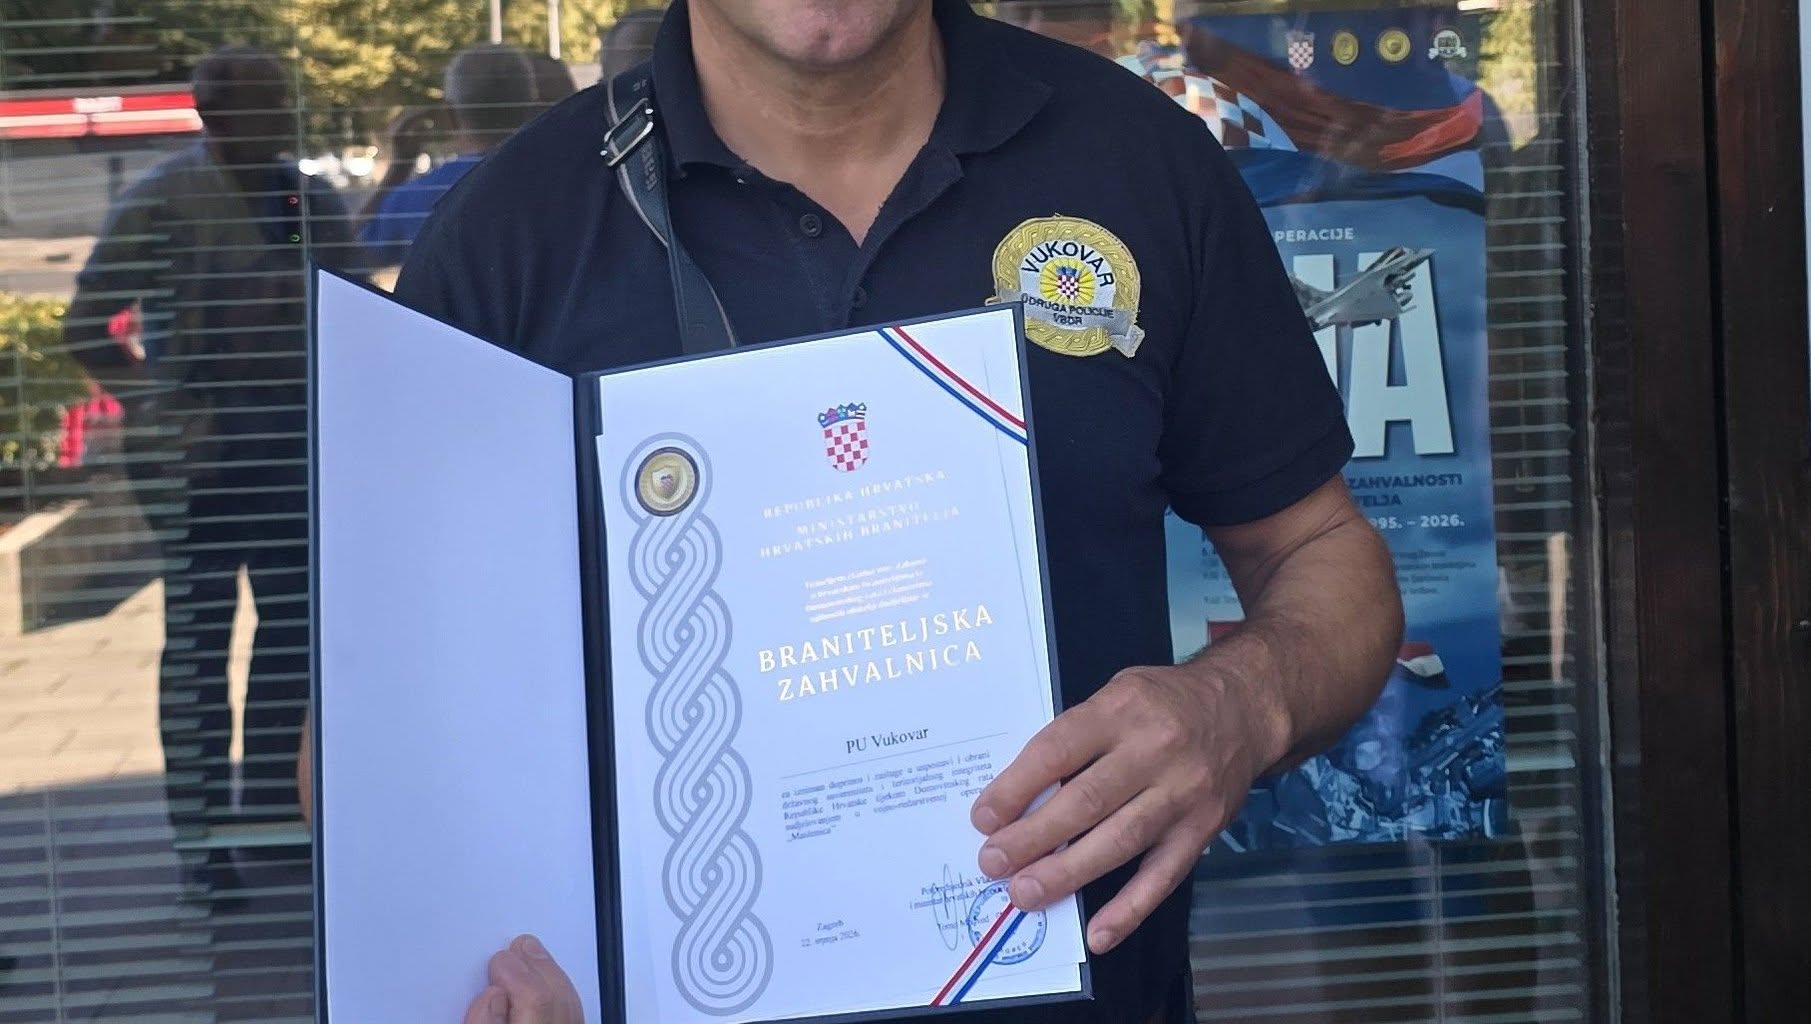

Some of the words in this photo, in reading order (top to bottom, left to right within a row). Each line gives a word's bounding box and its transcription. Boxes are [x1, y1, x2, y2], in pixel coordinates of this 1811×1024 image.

[1274, 227, 1354, 243] PERACIJE
[1021, 240, 1115, 288] VUKOVAR
[1348, 473, 1462, 489] ZAHVALNOSTI
[1353, 494, 1402, 507] TELJA
[1367, 516, 1402, 529] 995.
[1420, 514, 1465, 527] 2026.
[758, 604, 993, 673] BRANITELJSKA
[778, 640, 982, 702] ZAHVALNICA
[846, 737, 867, 754] PU
[871, 727, 929, 749] Vukovar
